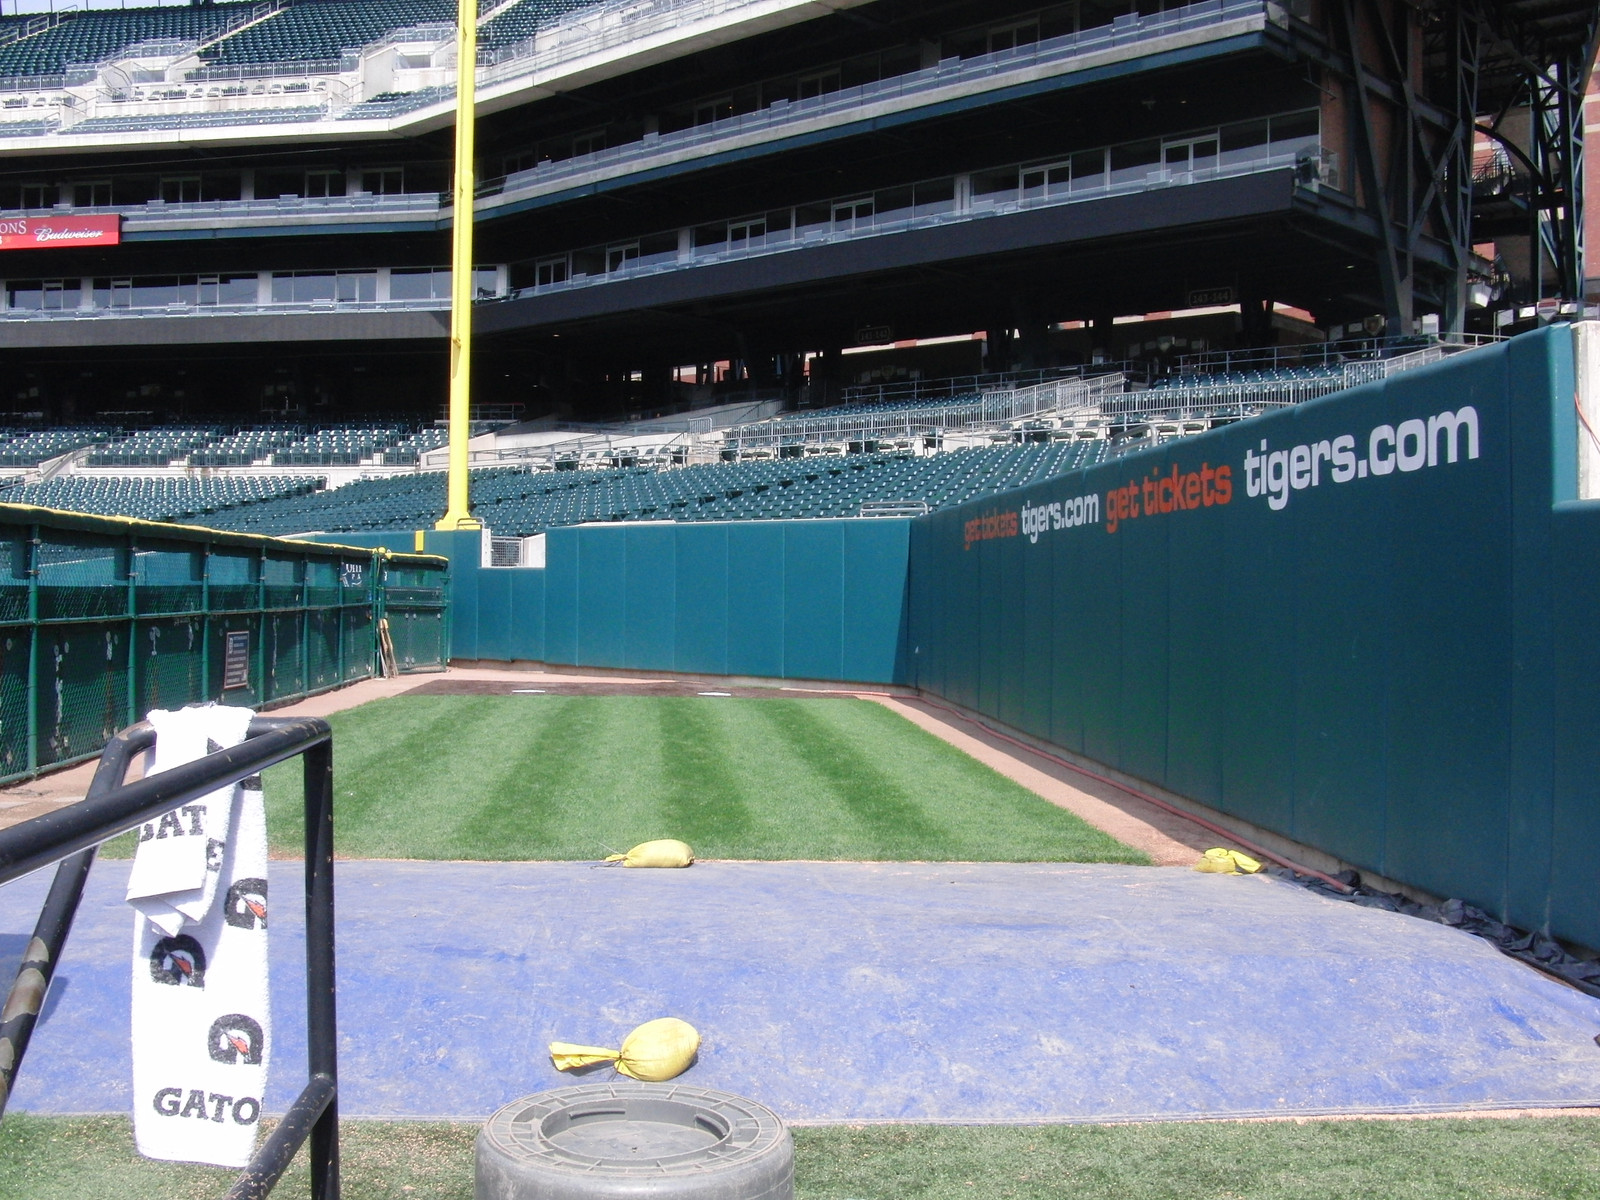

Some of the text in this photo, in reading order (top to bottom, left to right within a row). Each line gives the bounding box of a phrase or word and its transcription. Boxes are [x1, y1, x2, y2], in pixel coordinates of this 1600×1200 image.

[34, 227, 103, 242] Budweiser
[964, 405, 1479, 551] get tickets tigers.com get tickets tigers.com
